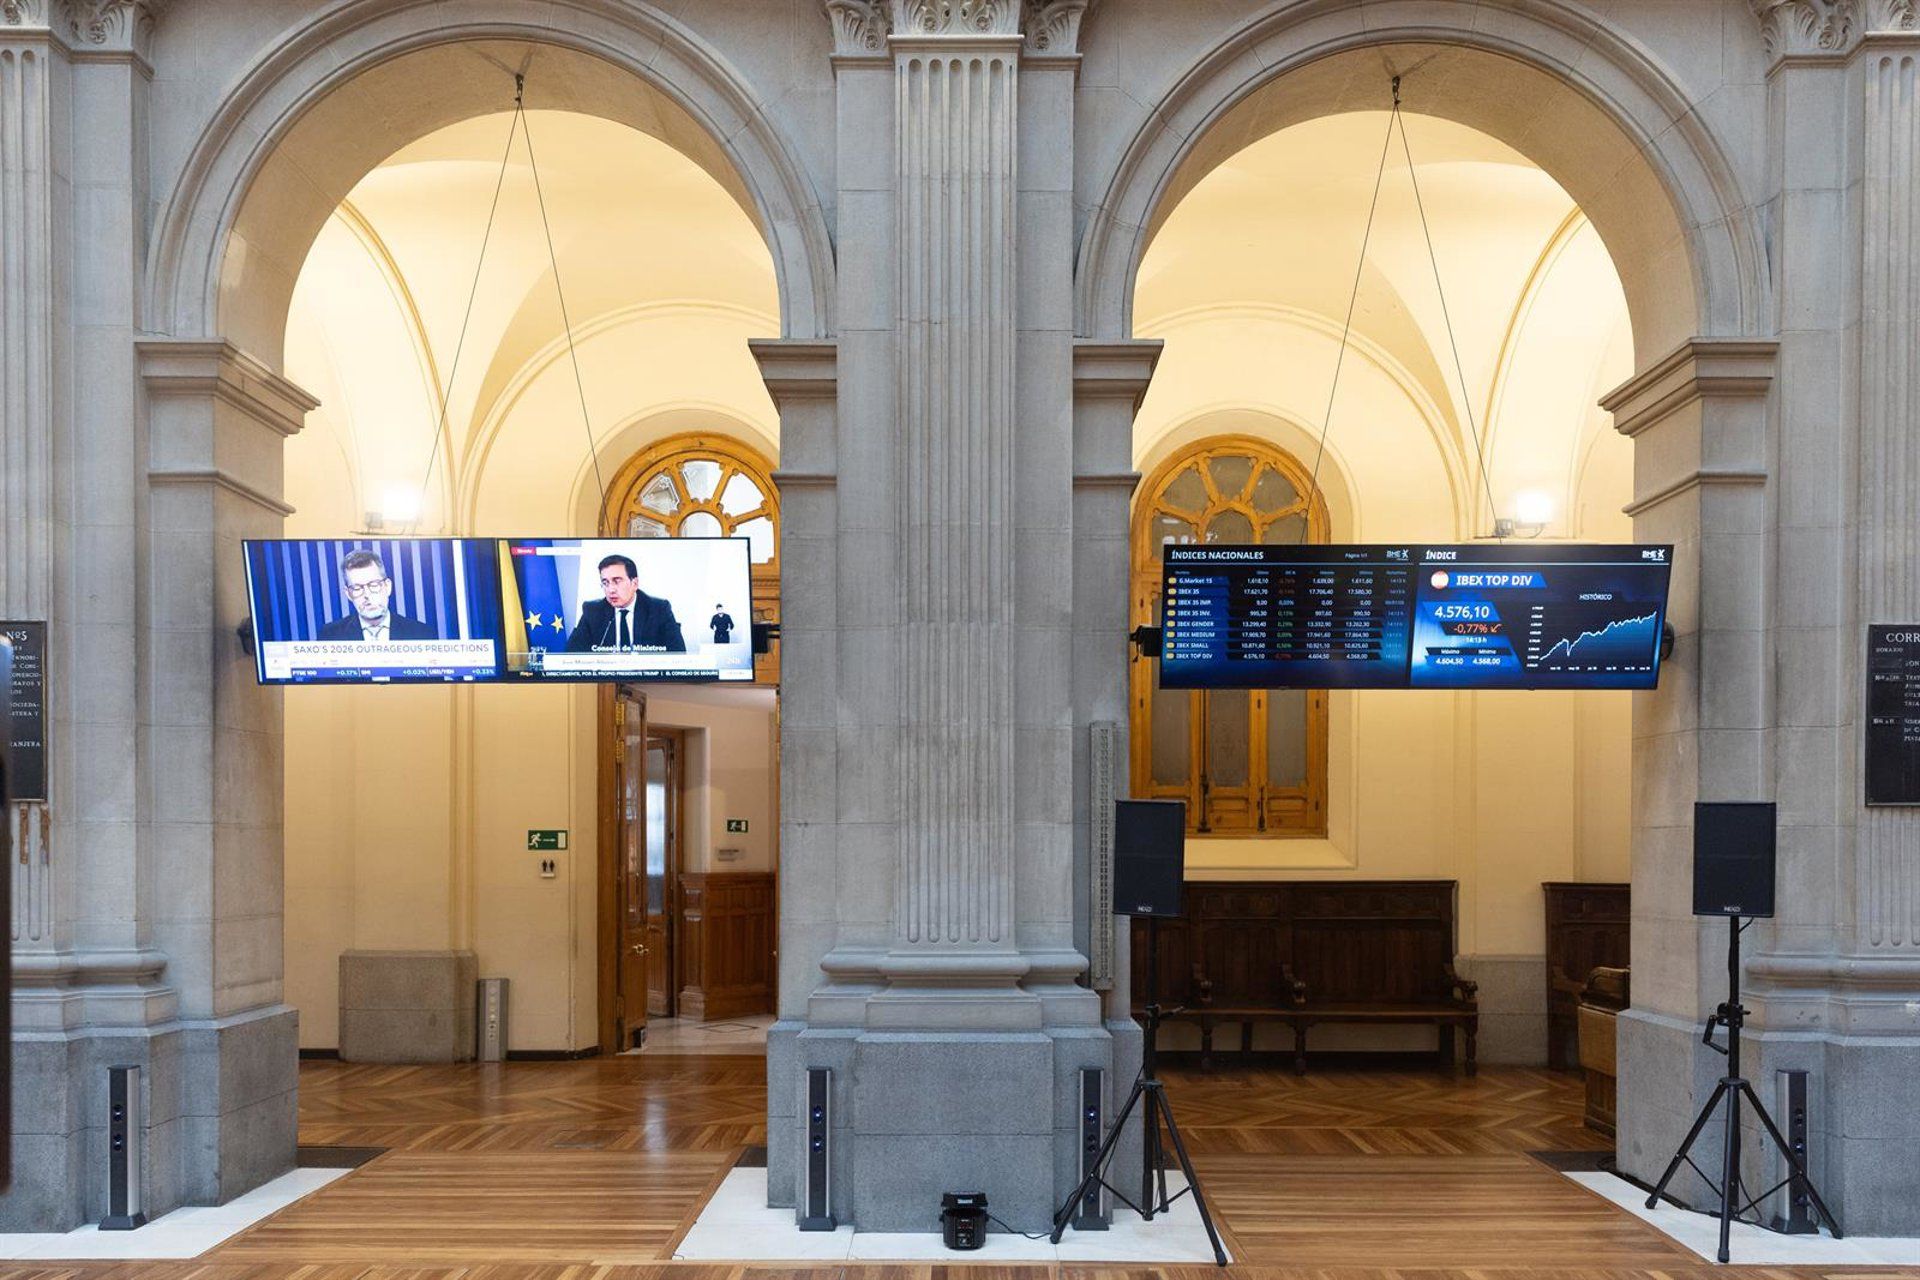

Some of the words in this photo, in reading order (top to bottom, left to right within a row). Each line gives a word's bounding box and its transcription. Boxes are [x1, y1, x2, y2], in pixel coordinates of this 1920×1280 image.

[1171, 550, 1206, 560] ÍNDICES
[1208, 551, 1264, 560] NACIONALES
[1426, 550, 1457, 560] ÍNDICE
[1456, 575, 1483, 586] IBEX
[1486, 575, 1509, 586] TOP
[1511, 575, 1533, 586] DIV
[1434, 605, 1490, 619] 4.576,10
[1453, 624, 1488, 634] -0,77%
[1886, 632, 1920, 643] CORR
[330, 645, 354, 653] 2026
[356, 644, 422, 653] OUTRAGEOUS
[426, 644, 489, 652] PREDICTIONS
[591, 645, 620, 653] Consejo
